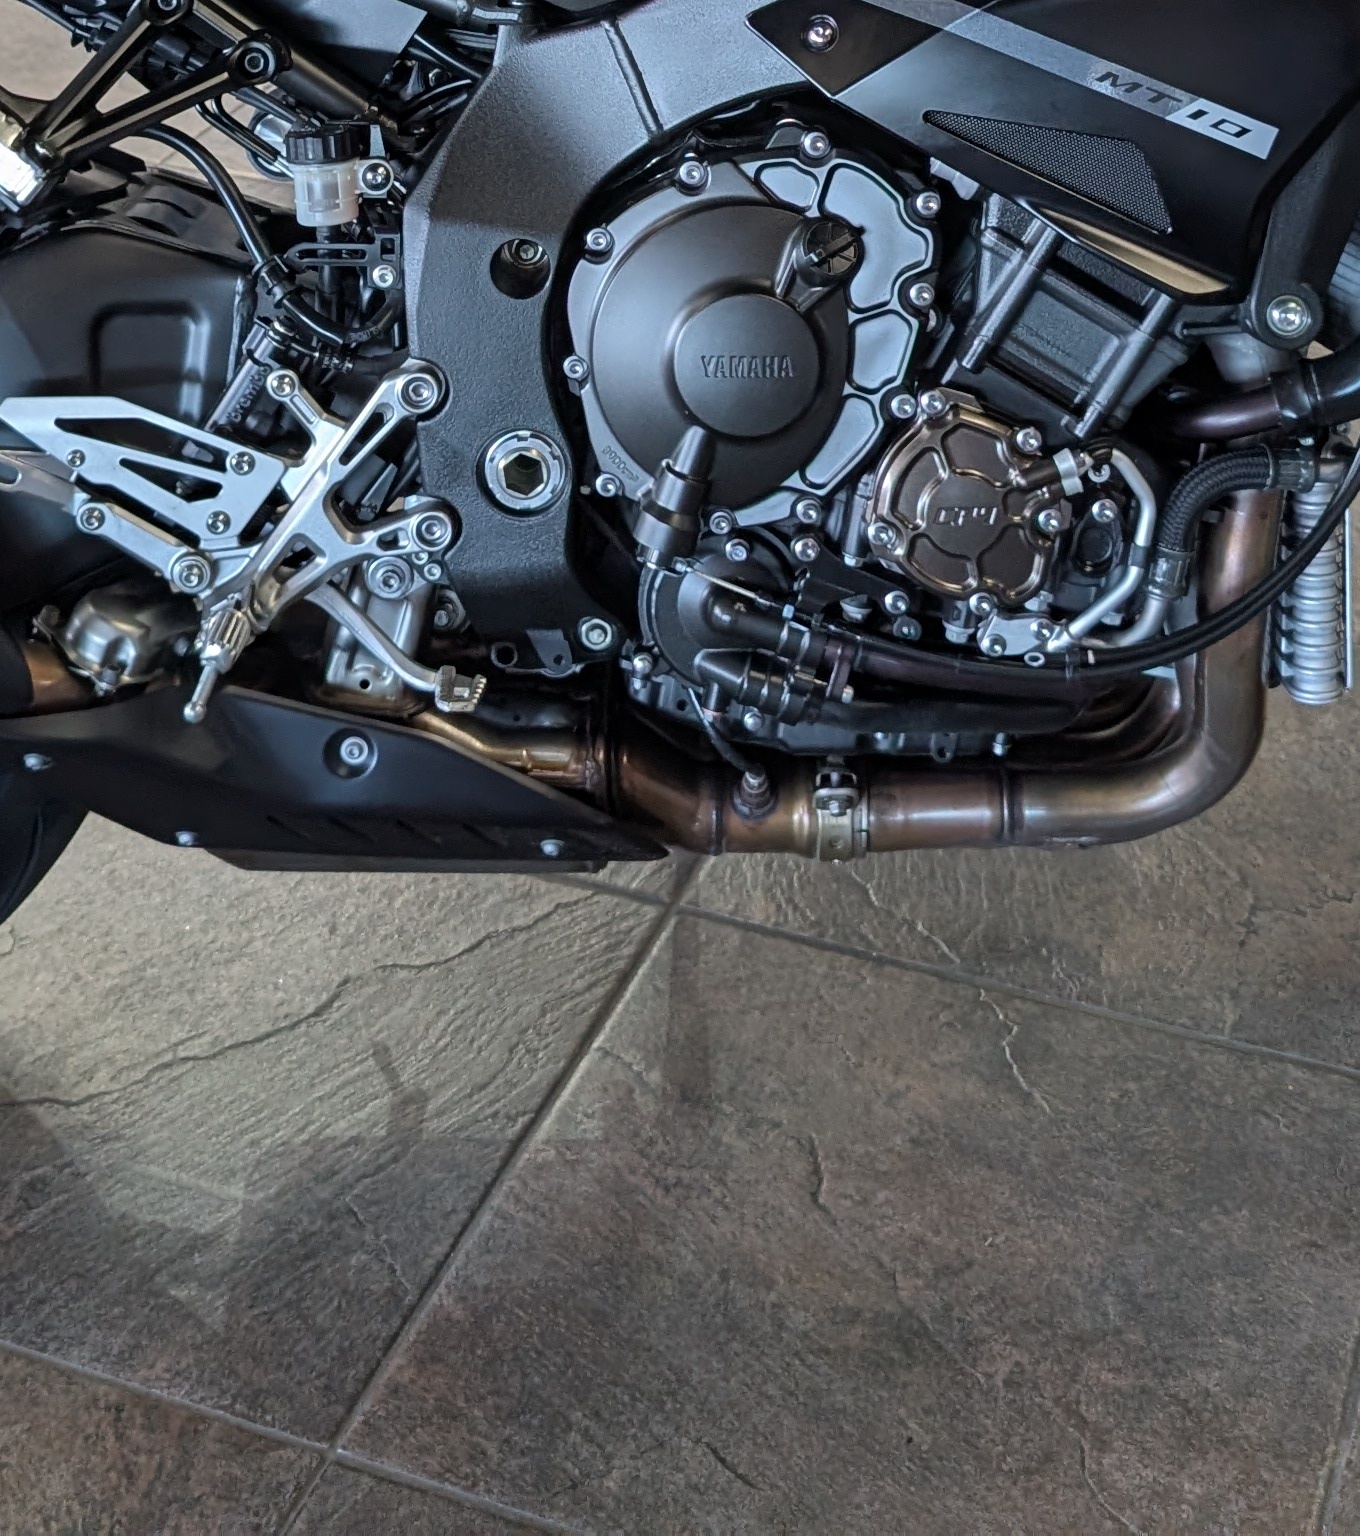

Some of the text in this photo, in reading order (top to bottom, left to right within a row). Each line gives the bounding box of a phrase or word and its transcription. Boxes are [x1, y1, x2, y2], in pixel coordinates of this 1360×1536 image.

[1096, 71, 1253, 140] MT 10
[700, 355, 794, 379] YAMAHA
